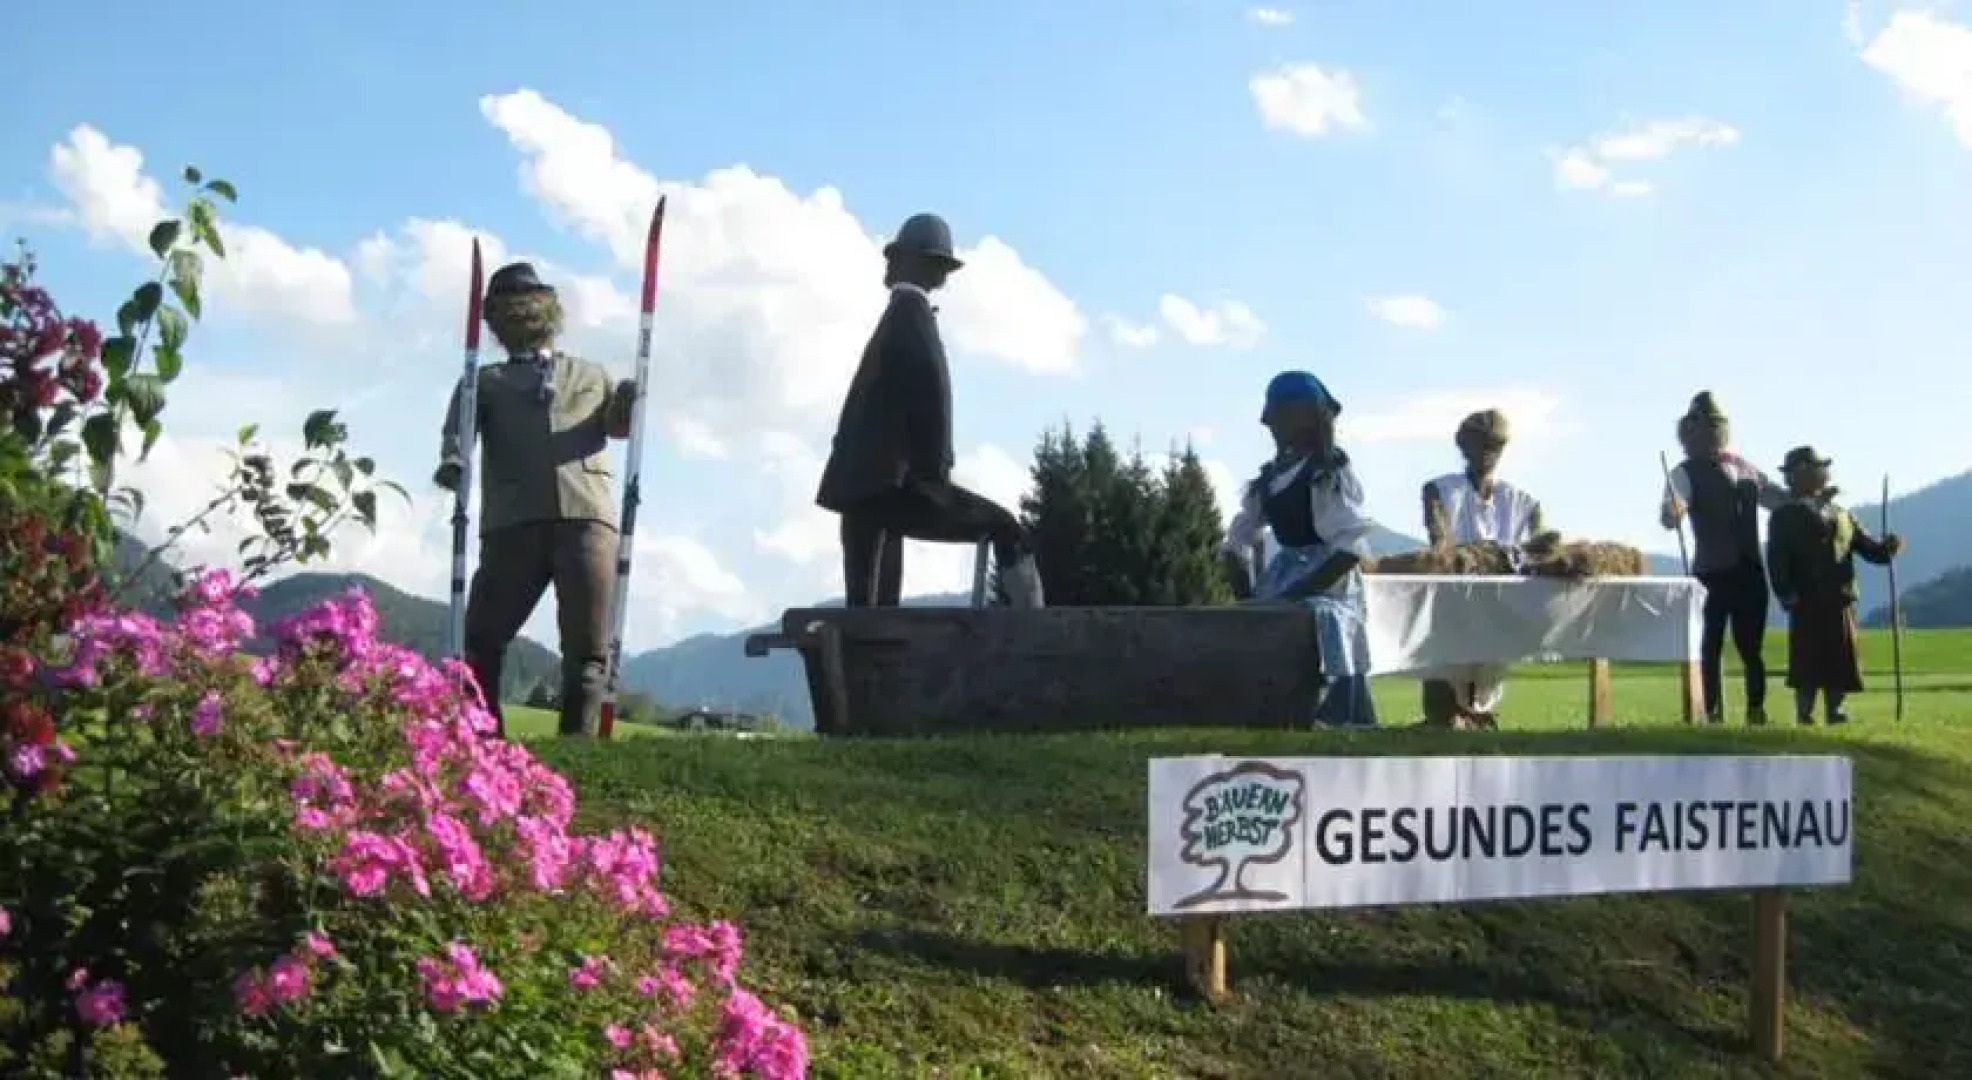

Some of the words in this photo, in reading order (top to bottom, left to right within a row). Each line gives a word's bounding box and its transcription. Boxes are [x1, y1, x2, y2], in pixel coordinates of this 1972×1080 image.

[1204, 783, 1290, 822] BAUERN
[1203, 817, 1280, 851] HERBST
[1316, 803, 1591, 865] GESUNDES
[1614, 799, 1849, 852] FAISTENAU
